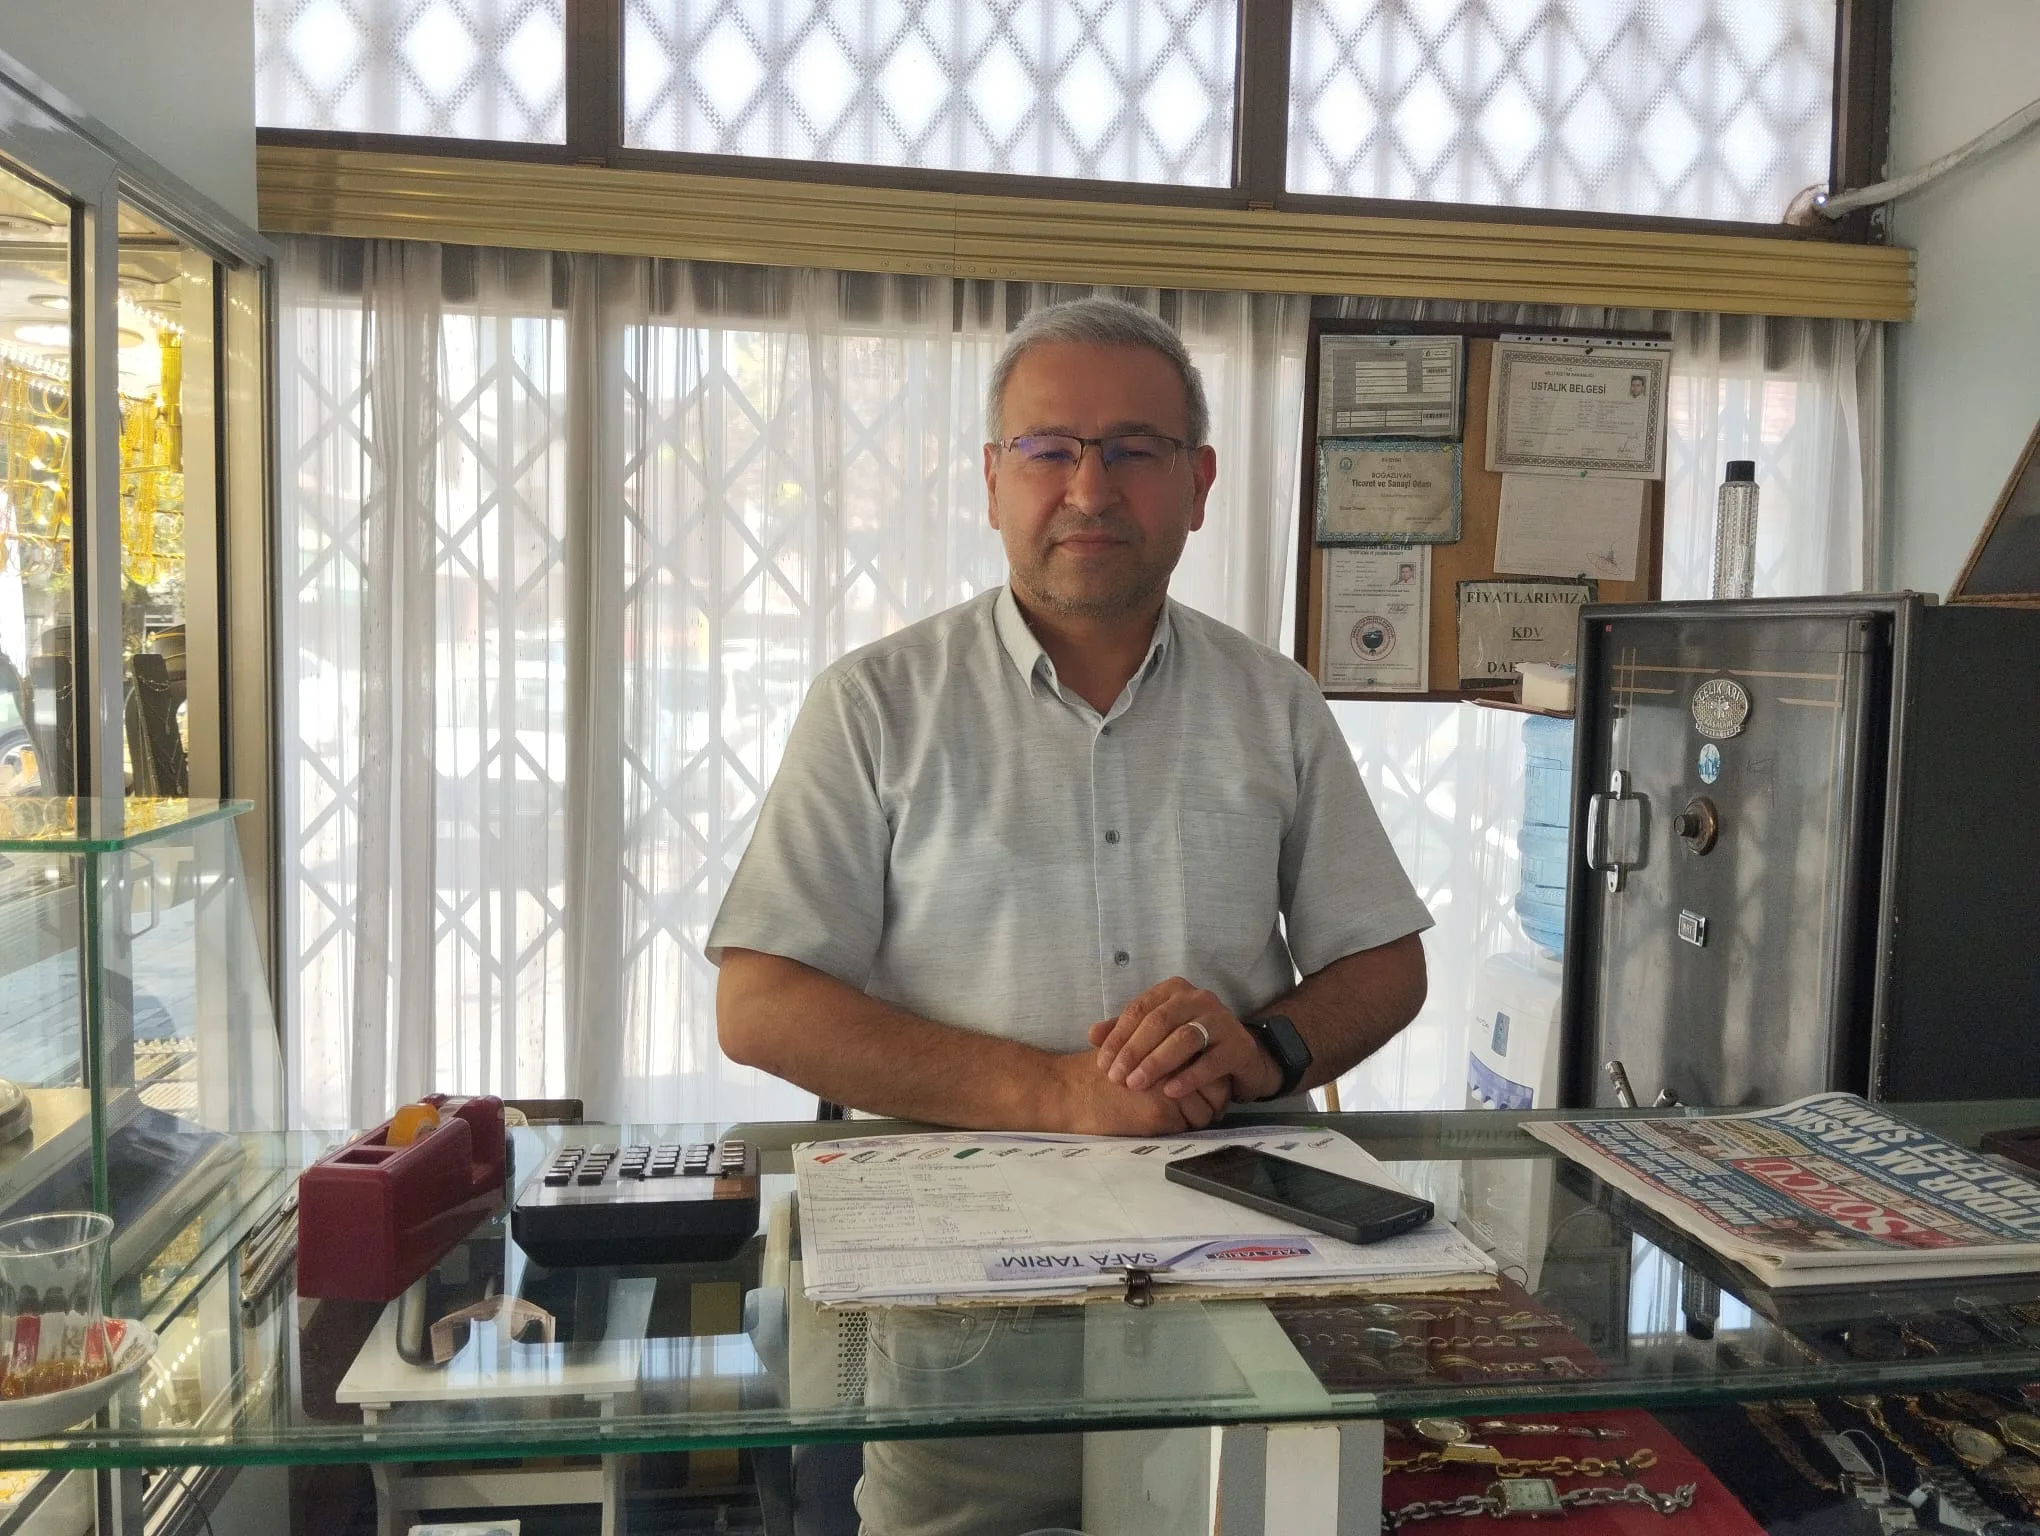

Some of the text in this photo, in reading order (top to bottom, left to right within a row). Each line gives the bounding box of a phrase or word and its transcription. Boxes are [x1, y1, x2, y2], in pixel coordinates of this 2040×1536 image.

[1531, 381, 1606, 394] USTALIK BELGESİ
[1351, 479, 1375, 488] Ticaret
[1388, 480, 1411, 489] Sanayi
[1467, 588, 1590, 604] FİYATLARIMIZA
[1511, 626, 1543, 638] KDV
[1739, 1161, 1927, 1233] SÖZCÜ
[1001, 1252, 1158, 1268] SAFA TARIM
